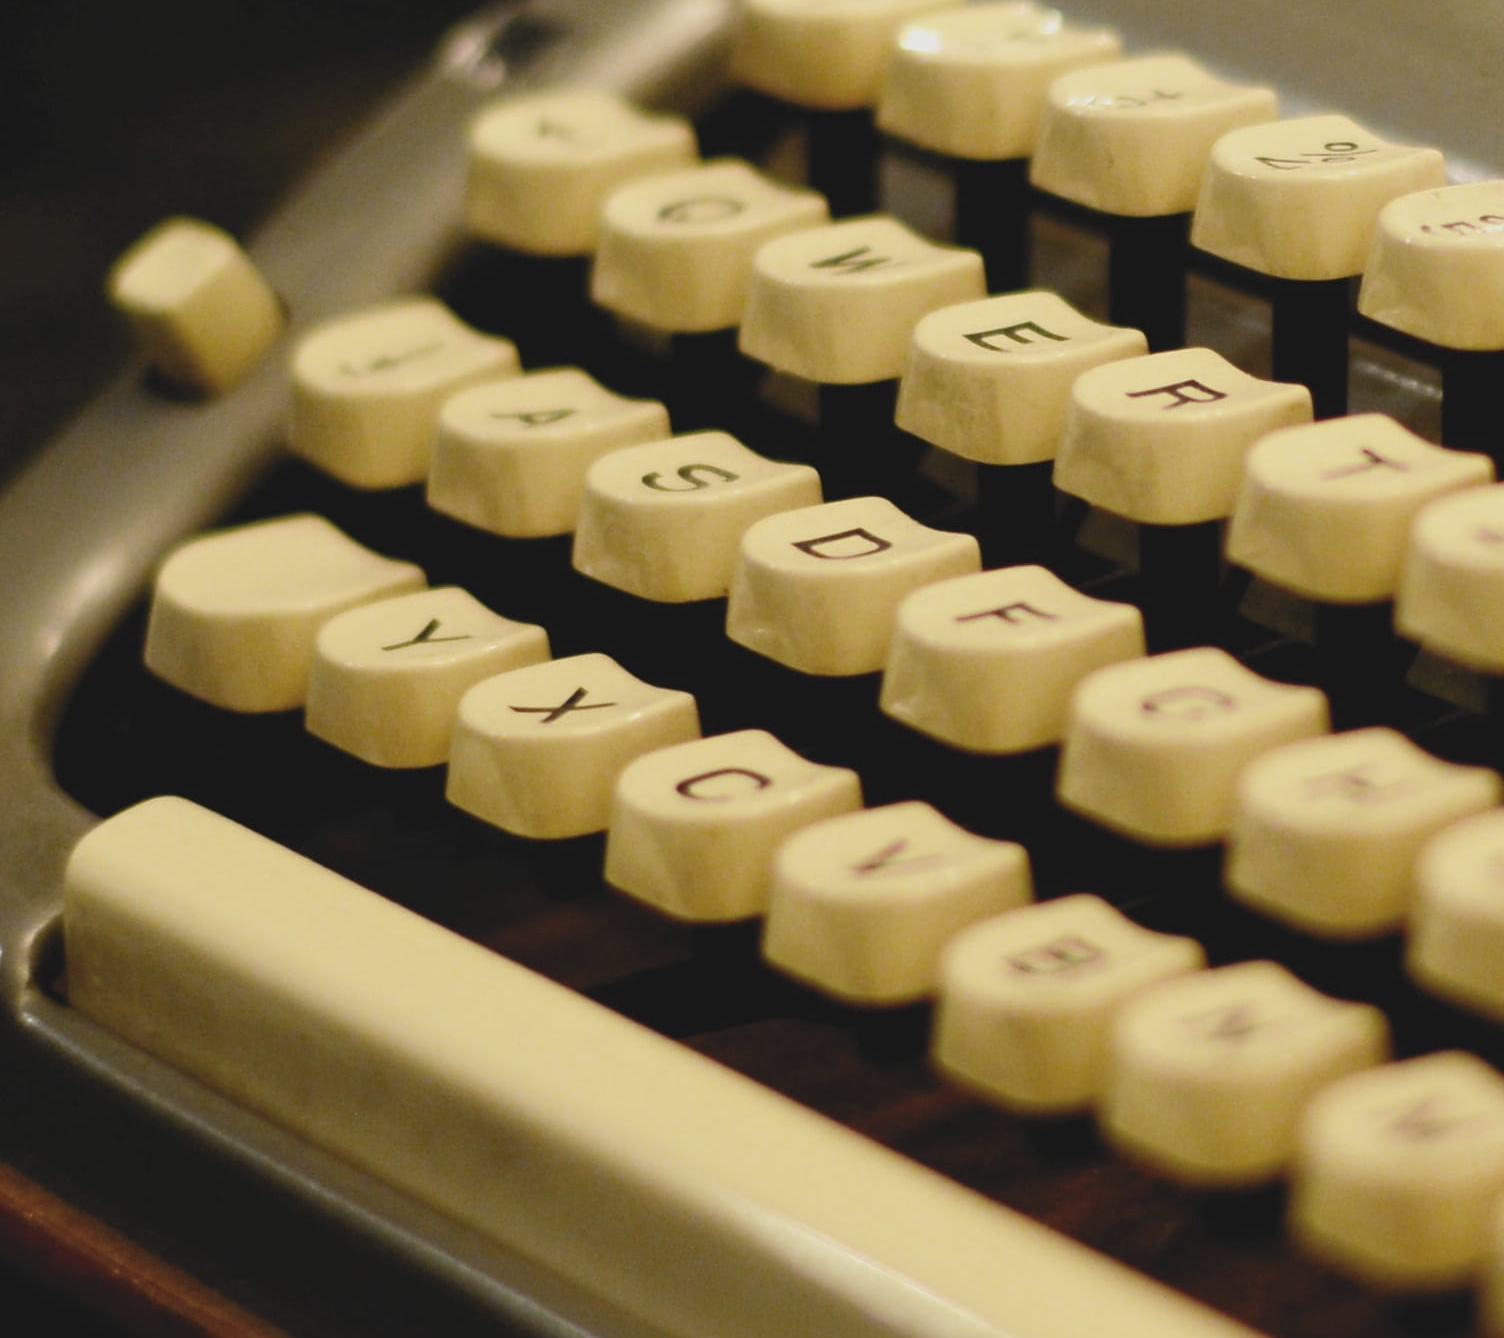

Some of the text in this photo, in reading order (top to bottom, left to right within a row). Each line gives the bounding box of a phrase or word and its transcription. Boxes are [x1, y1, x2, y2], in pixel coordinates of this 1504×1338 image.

[809, 245, 890, 277] W
[963, 319, 1072, 355] E
[1125, 377, 1229, 412] R
[490, 407, 578, 427] A
[641, 462, 740, 495] S
[1323, 446, 1410, 482] T
[790, 526, 894, 561] D
[954, 601, 1062, 628] F
[380, 617, 472, 654] Y
[508, 686, 619, 725] X
[675, 766, 773, 805] C
